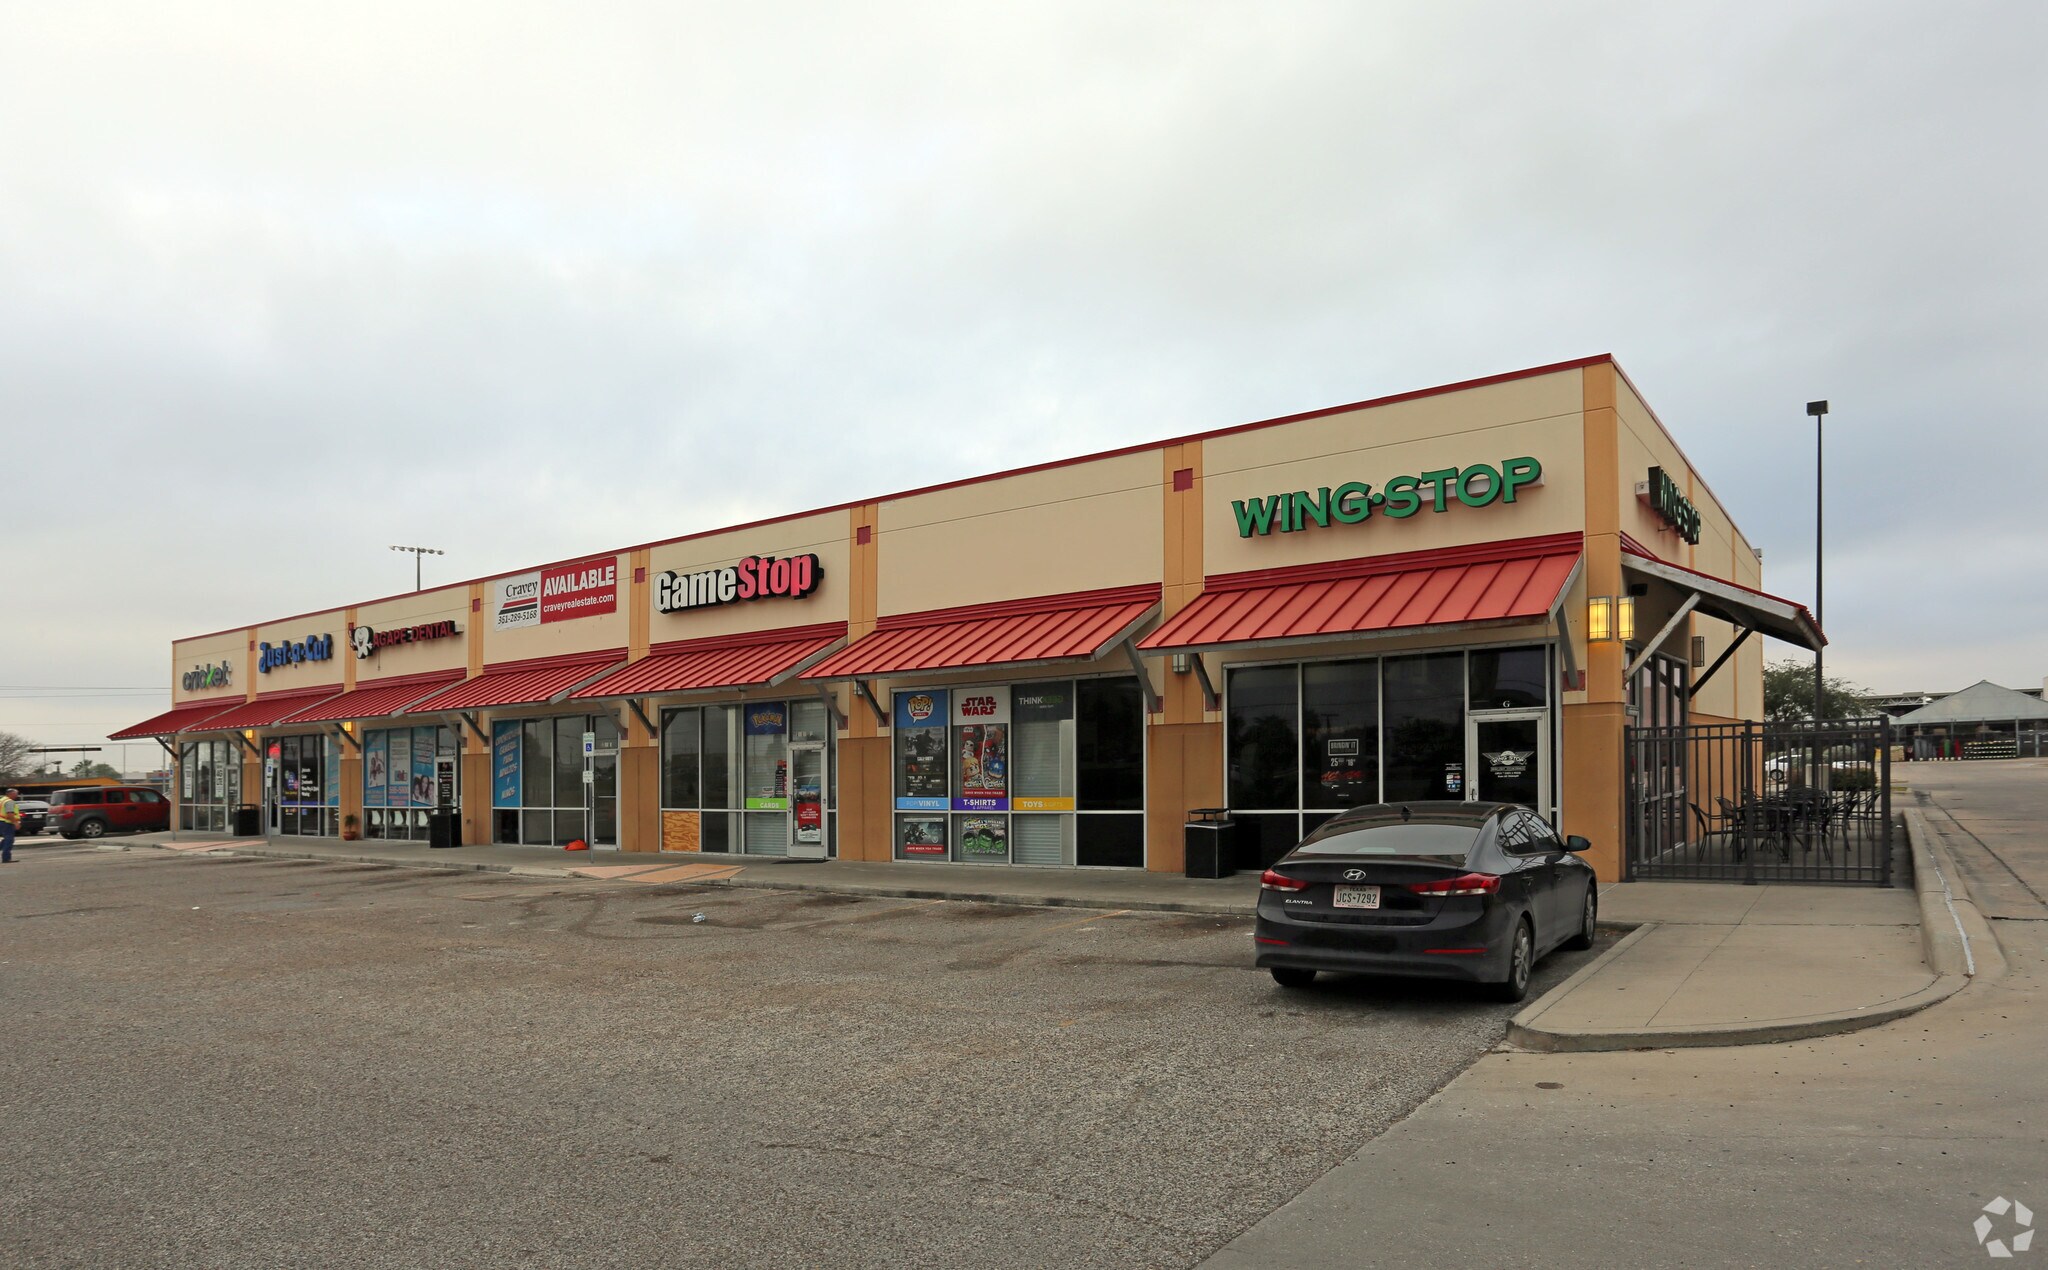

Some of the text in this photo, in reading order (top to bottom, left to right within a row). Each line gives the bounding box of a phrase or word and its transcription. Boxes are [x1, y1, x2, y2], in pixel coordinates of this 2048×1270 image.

[506, 581, 538, 597] Cravey
[543, 566, 615, 597] AVAILABLE
[653, 554, 813, 612] GameStop
[543, 594, 614, 613] craveyrealestate.com
[373, 620, 455, 648] AGAPE DENTAL
[182, 660, 230, 691] cricket
[961, 696, 997, 707] STAR
[961, 706, 997, 716] WARS
[1502, 700, 1510, 708] G
